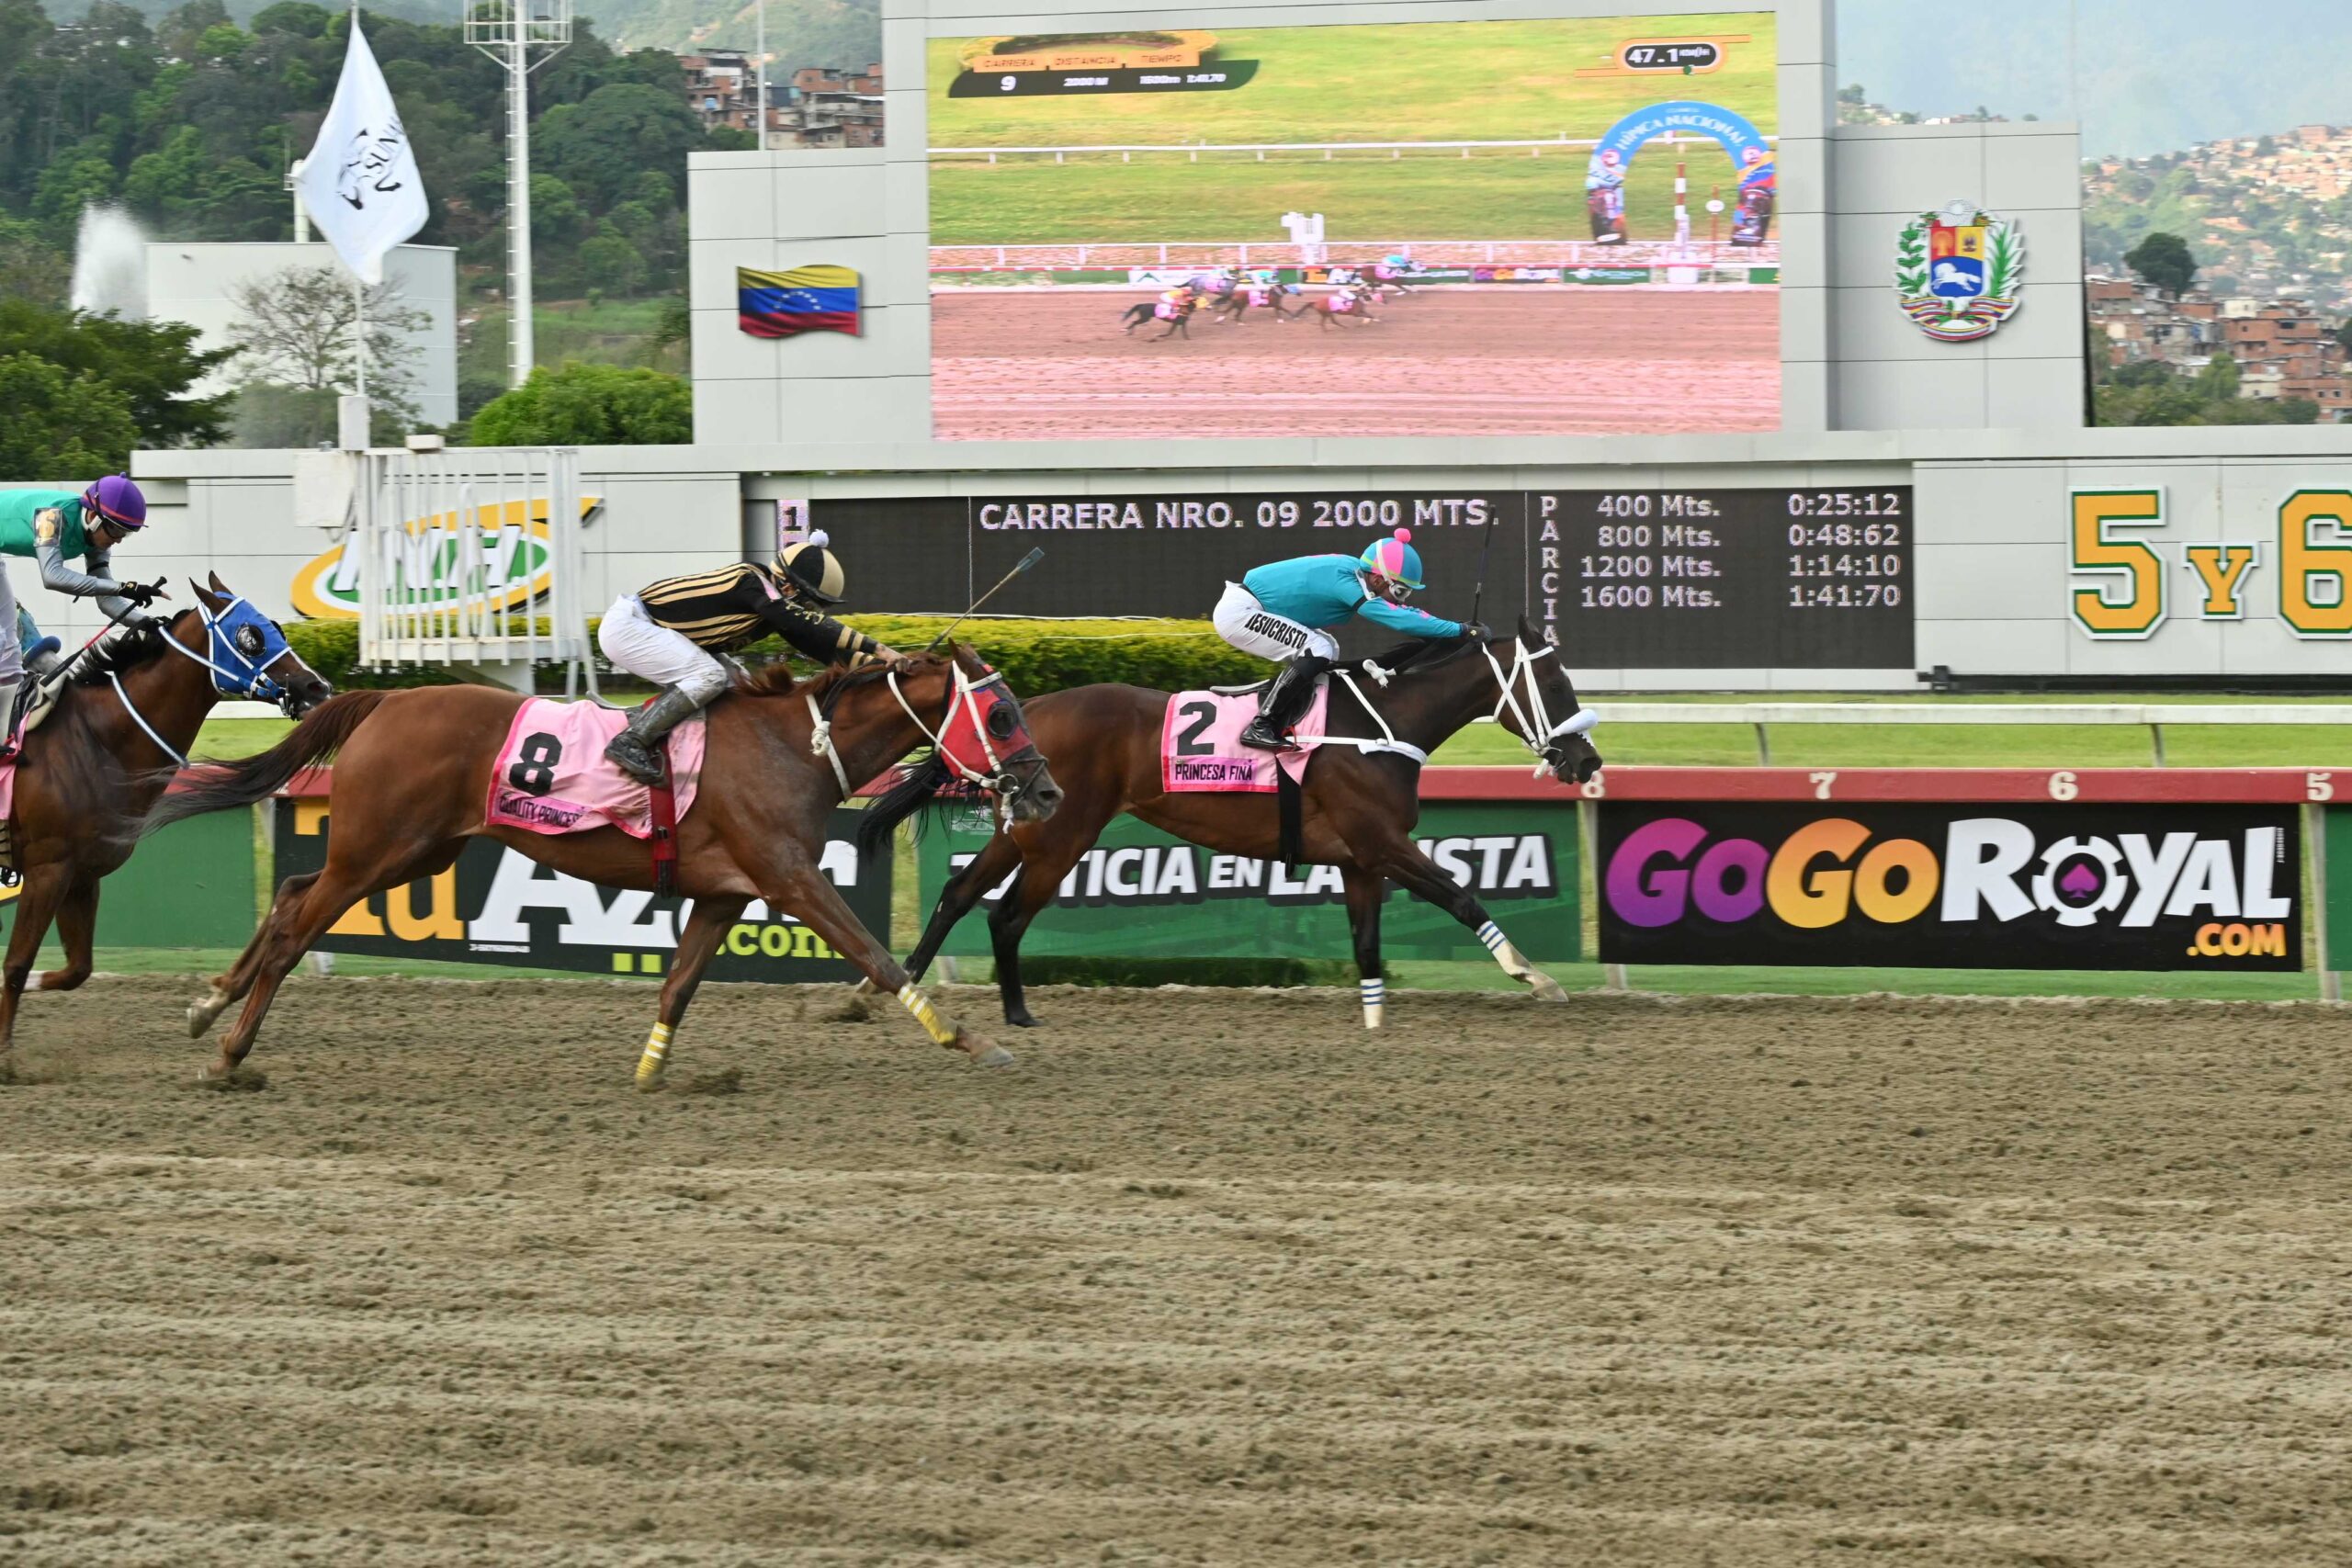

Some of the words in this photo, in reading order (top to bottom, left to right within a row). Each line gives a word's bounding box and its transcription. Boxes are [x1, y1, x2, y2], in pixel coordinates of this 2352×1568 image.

[984, 59, 1035, 68] CARRERA
[1628, 49, 1678, 63] 47.1
[1000, 75, 1016, 91] 9
[784, 506, 802, 531] 1
[979, 502, 1146, 531] CARRERA
[1156, 502, 1245, 529] NRO.
[1257, 501, 1301, 529] 09
[1313, 500, 1401, 528] 2000
[1414, 498, 1499, 526] MTS.
[1597, 496, 1651, 517] 400
[1661, 495, 1721, 517] Mts.
[1788, 493, 1901, 516] 0:25:12
[1598, 525, 1652, 547] 800
[1661, 525, 1721, 547] Mts.
[1788, 524, 1901, 547] 0:48:62
[1580, 556, 1652, 578] 1200
[1662, 555, 1722, 577] Mts.
[1789, 554, 1901, 577] 1:14:10
[2068, 486, 2166, 640] 5
[2276, 484, 2352, 640] 6
[1580, 586, 1652, 608] 1600
[1662, 585, 1722, 607] Mts.
[1789, 584, 1901, 607] 1:41:70
[1176, 701, 1217, 756] 2
[509, 731, 562, 797] 8
[1175, 763, 1226, 781] PRINCESA
[1580, 771, 1606, 798] 8
[1809, 772, 1837, 800] 7
[2048, 772, 2078, 800] 6
[2307, 773, 2335, 802] 5
[1208, 854, 1263, 888] EN
[2187, 922, 2287, 958] .COM
